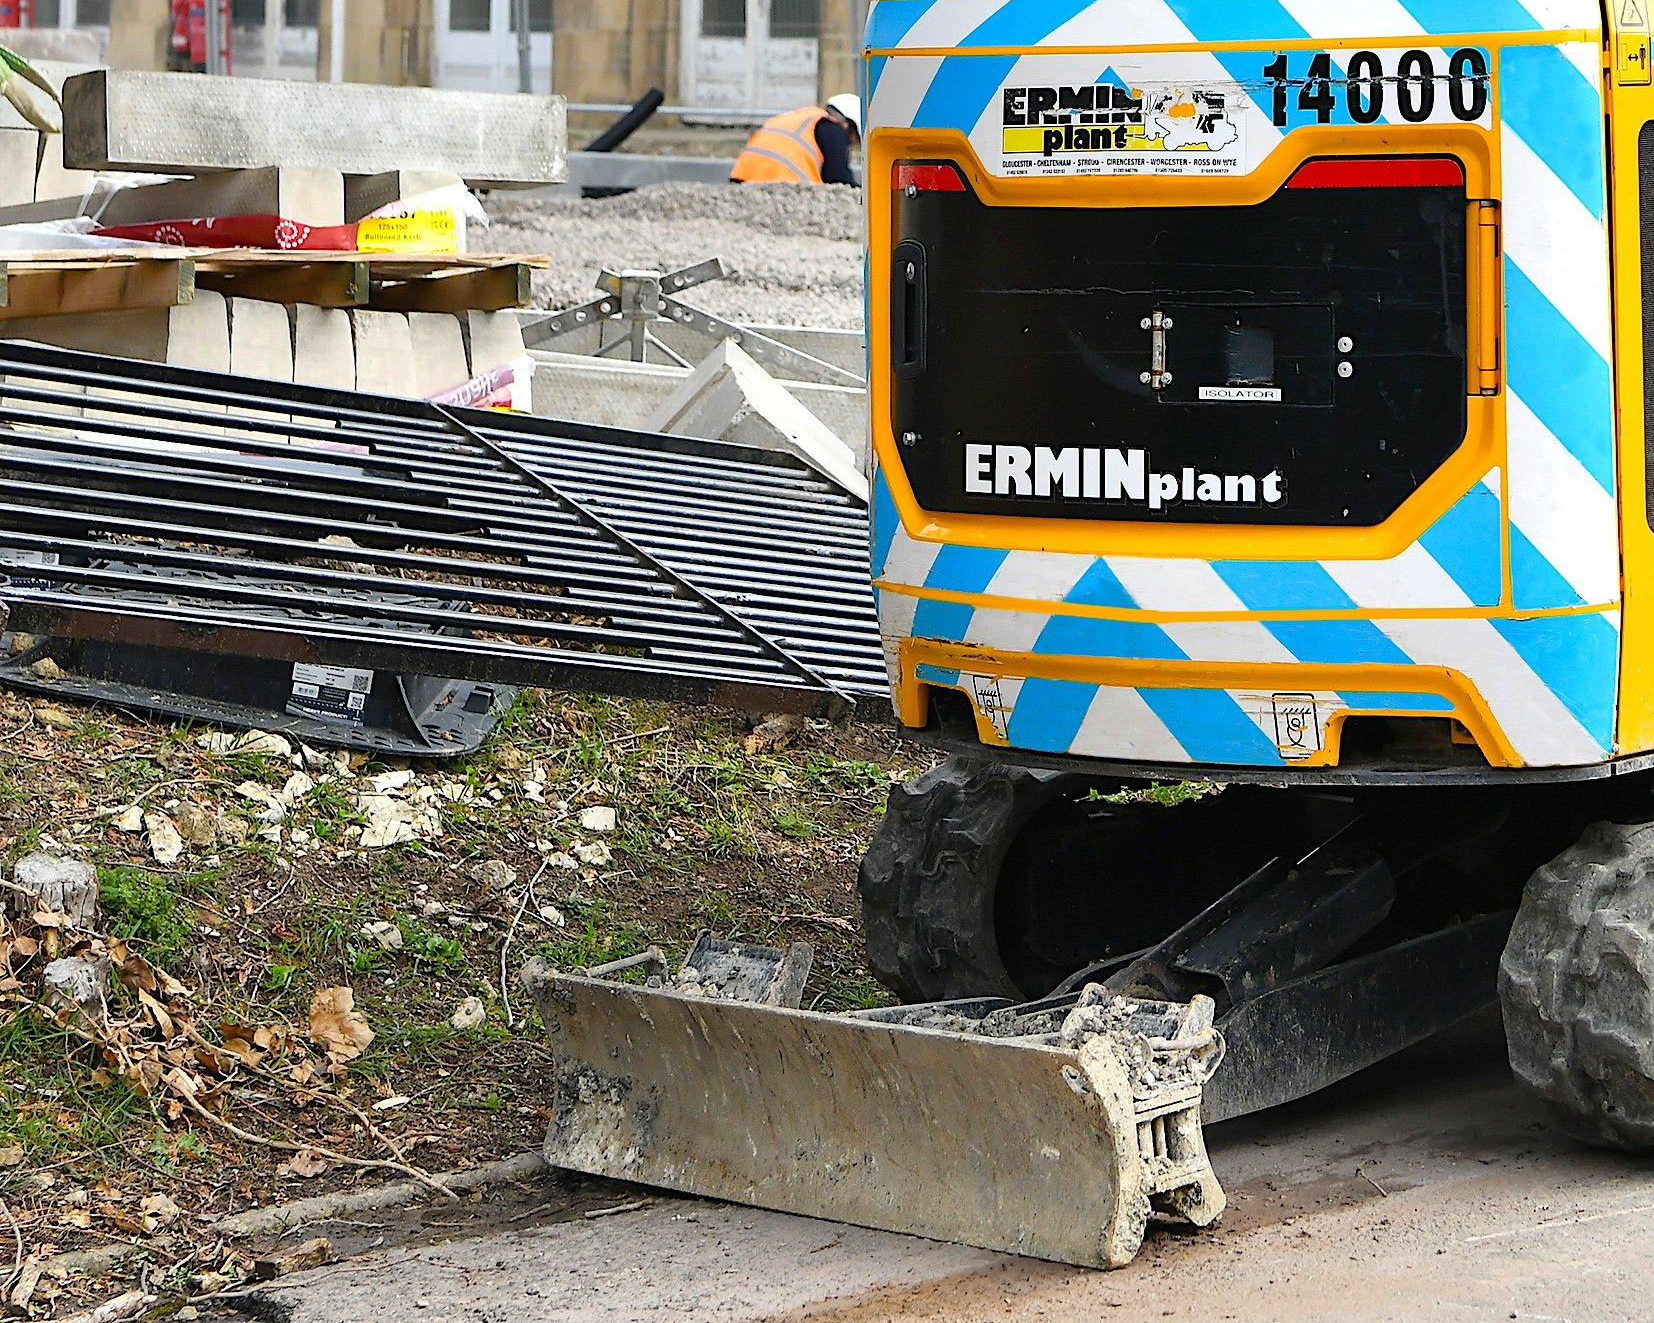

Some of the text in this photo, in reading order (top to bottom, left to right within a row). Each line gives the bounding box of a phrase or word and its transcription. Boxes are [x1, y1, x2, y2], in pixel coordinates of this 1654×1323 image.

[1263, 48, 1488, 127] 14000
[1003, 85, 1143, 126] ERMIN
[1043, 125, 1128, 157] plant
[1106, 158, 1146, 166] CIRENCESTER
[1150, 158, 1188, 166] WORCESTER
[1193, 158, 1211, 166] ROSS
[1212, 158, 1222, 166] ON
[1204, 389, 1275, 399] ISOLATOR
